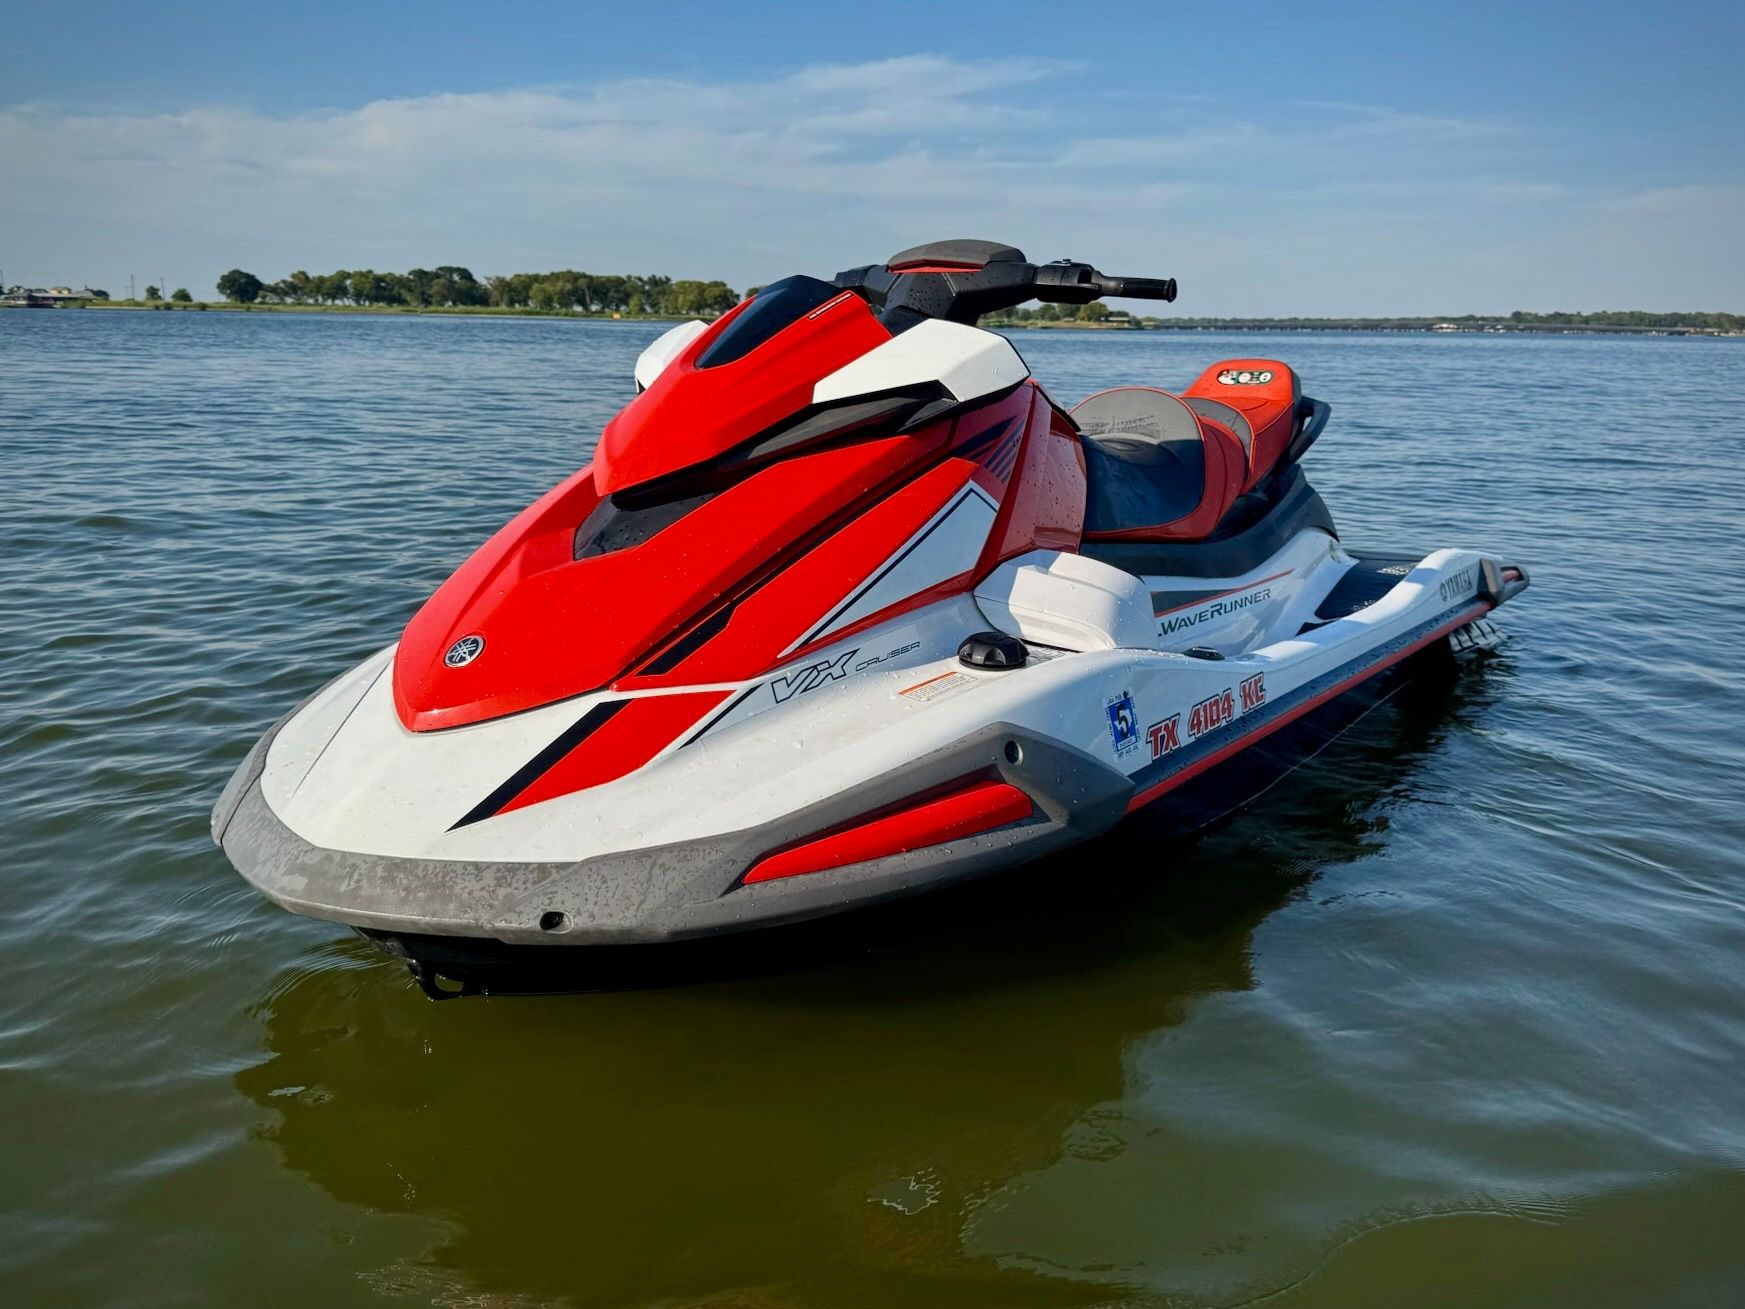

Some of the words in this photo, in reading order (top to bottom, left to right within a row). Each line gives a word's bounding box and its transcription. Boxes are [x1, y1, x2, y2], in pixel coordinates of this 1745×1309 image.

[771, 648, 860, 704] VX
[855, 641, 921, 672] CRUISER
[1116, 703, 1130, 740] 5
[1146, 712, 1181, 761] TX
[1188, 687, 1235, 740] 4104
